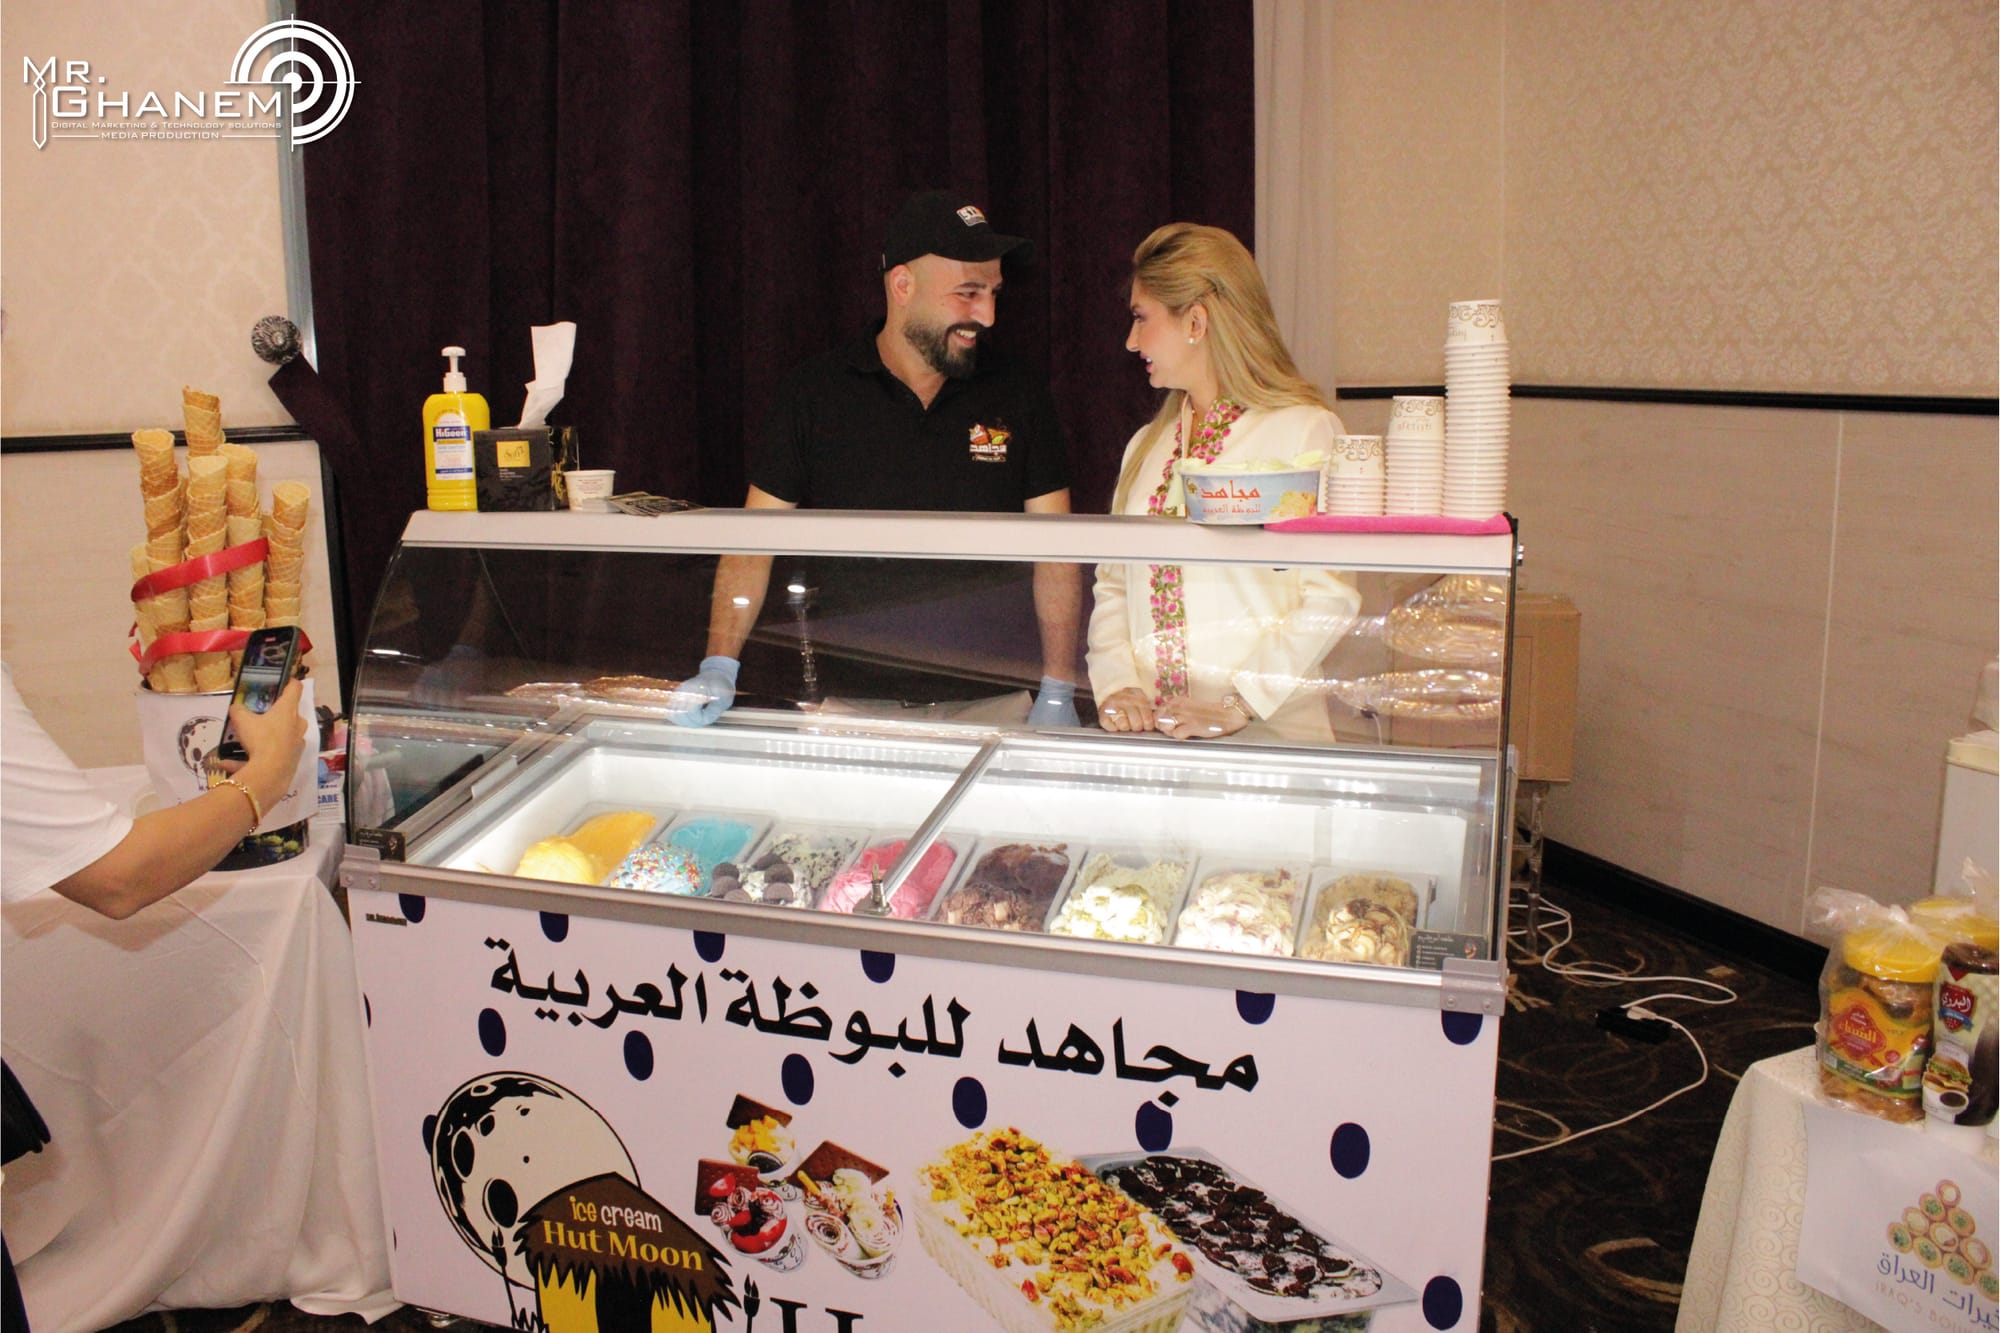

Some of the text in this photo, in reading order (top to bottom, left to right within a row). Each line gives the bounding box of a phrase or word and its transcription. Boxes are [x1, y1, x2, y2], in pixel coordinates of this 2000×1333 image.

[1201, 479, 1260, 502] مجاهد
[485, 938, 1259, 1108] مجاهد للبوظة العربية
[571, 1195, 663, 1233] ice cream
[543, 1220, 704, 1272] Hut Moon
[1877, 1252, 1935, 1294] العراق
